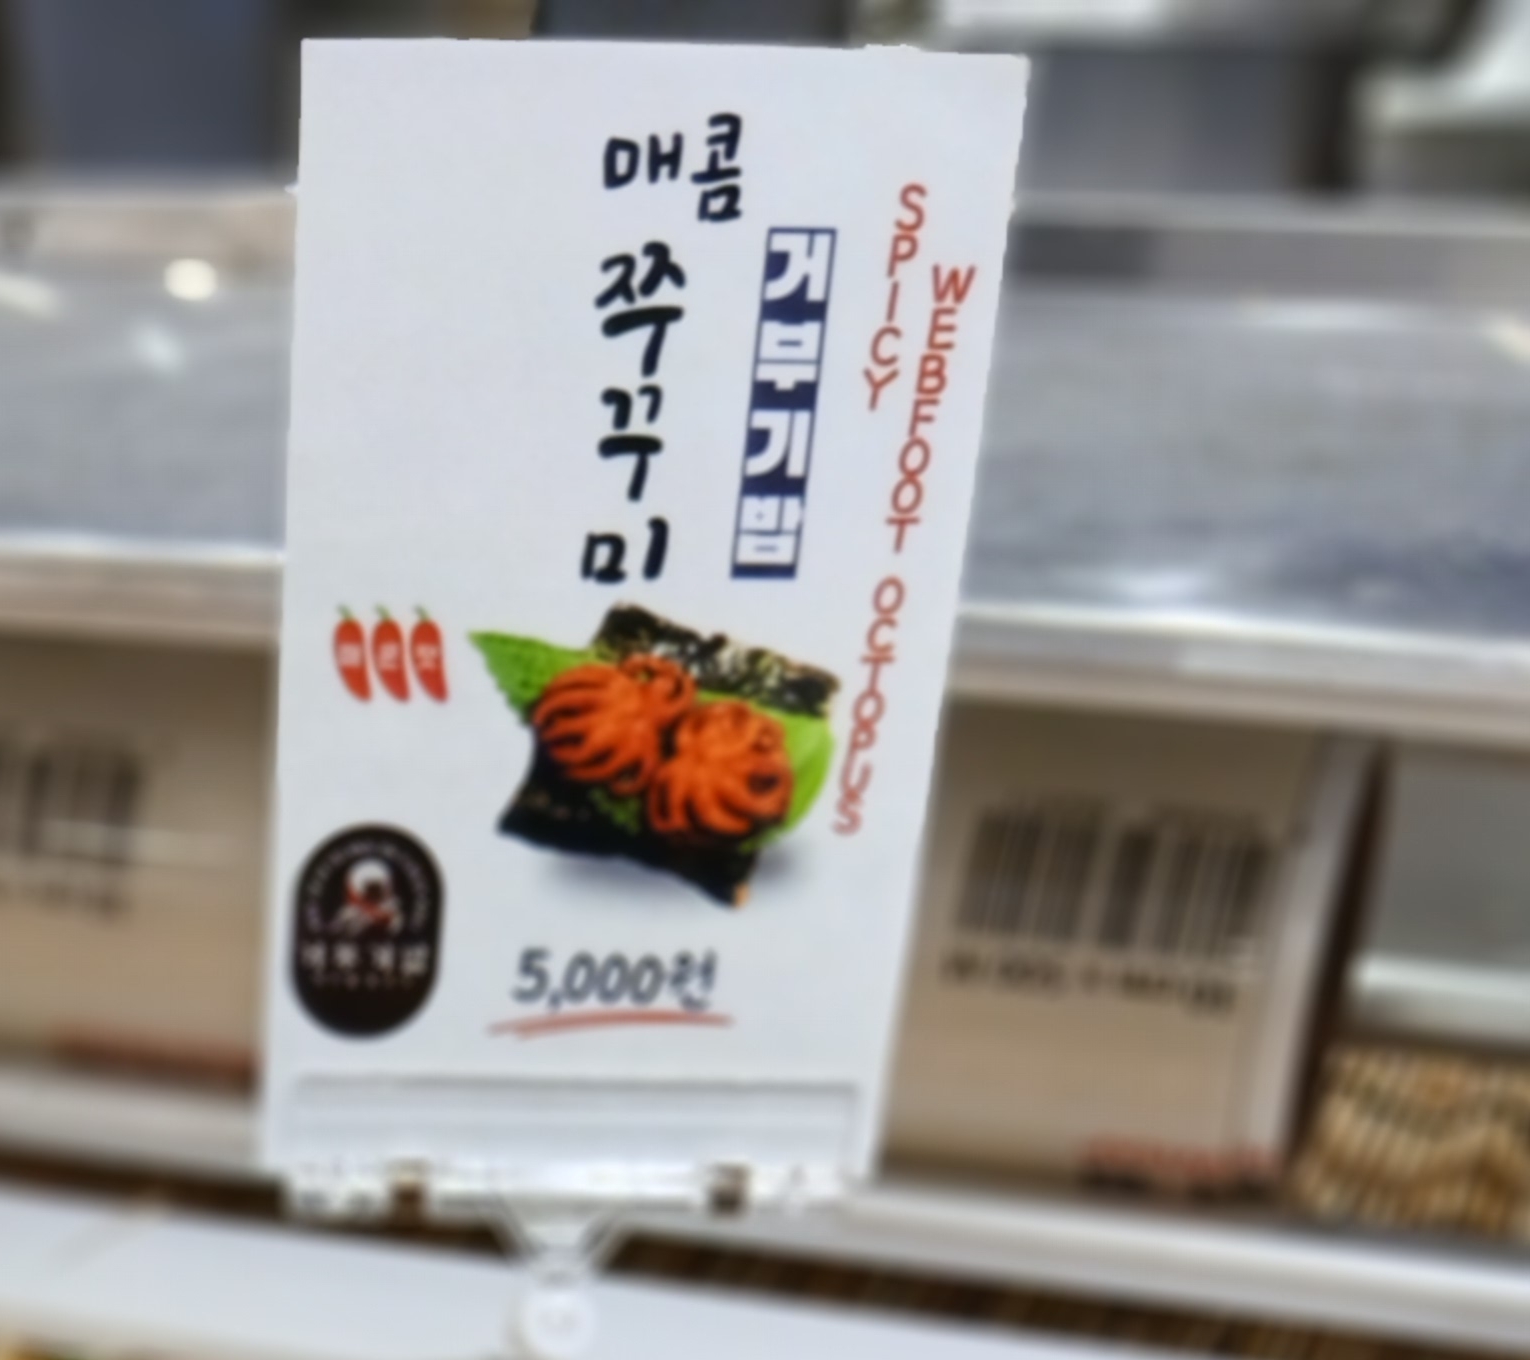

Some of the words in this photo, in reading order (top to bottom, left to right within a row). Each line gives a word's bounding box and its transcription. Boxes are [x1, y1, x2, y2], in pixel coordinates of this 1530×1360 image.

[602, 112, 743, 222] 매콤
[863, 182, 927, 411] SPICY
[580, 240, 686, 583] 쭈꾸미
[732, 228, 837, 580] 거부기밥
[884, 263, 977, 553] WEBFOOT
[830, 574, 906, 837] OCTOPUS
[510, 947, 718, 1013] 5,000원
